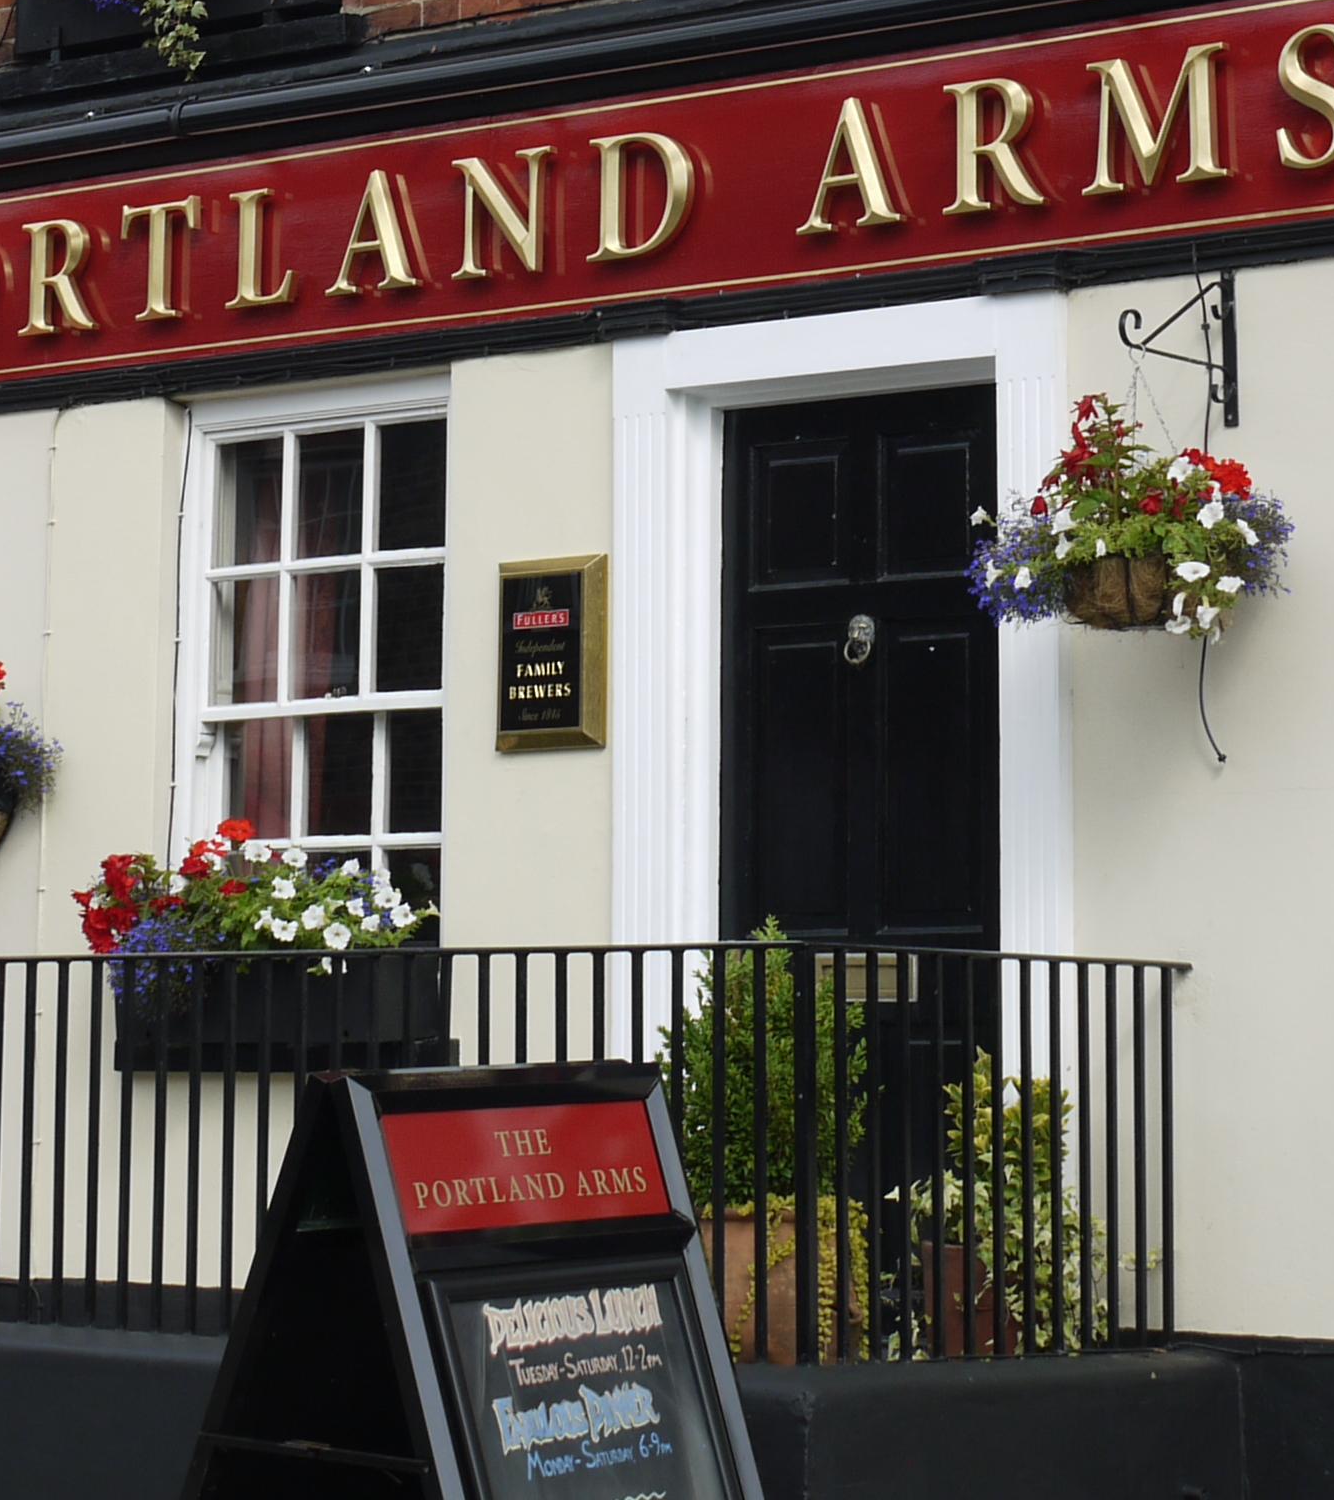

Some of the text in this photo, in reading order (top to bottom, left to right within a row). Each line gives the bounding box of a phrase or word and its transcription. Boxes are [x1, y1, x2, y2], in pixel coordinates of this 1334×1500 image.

[516, 661, 565, 678] FAMILY
[509, 683, 571, 700] BREWERS
[494, 1128, 552, 1157] THE
[413, 1166, 648, 1209] PORTLAND ARMS
